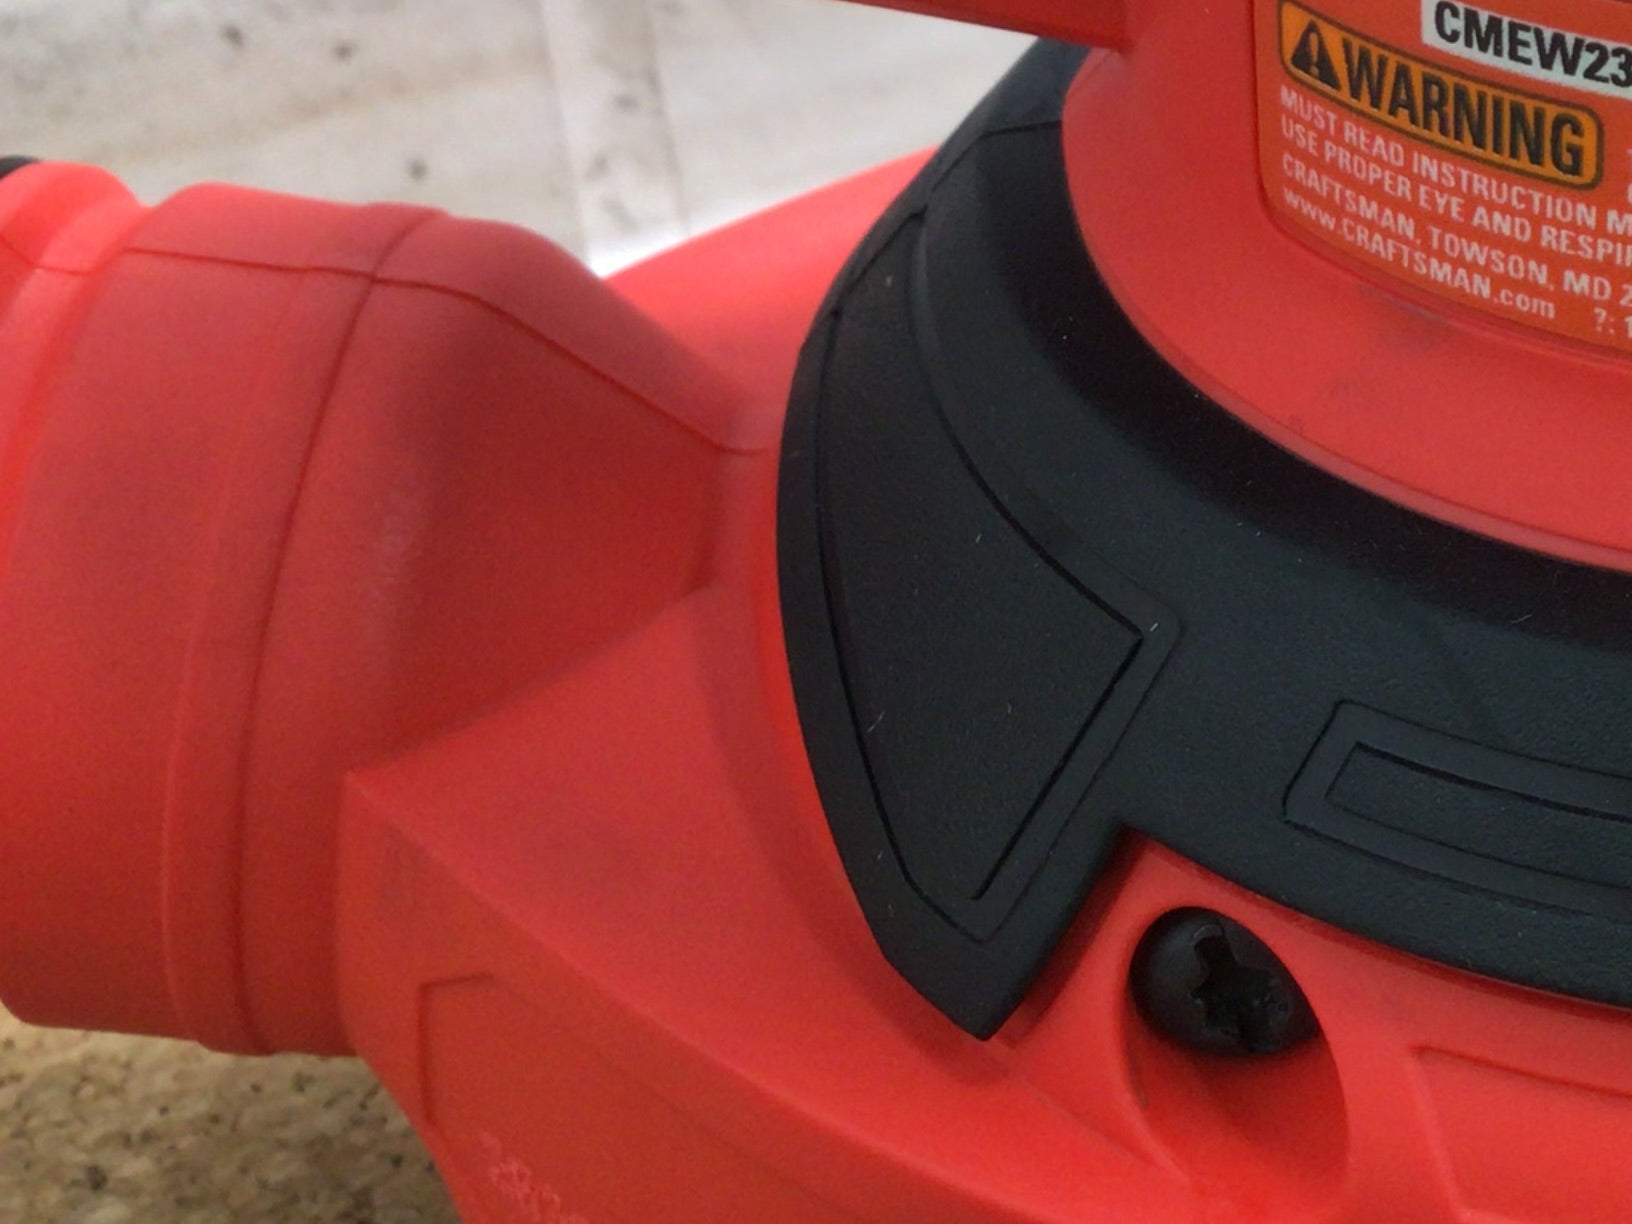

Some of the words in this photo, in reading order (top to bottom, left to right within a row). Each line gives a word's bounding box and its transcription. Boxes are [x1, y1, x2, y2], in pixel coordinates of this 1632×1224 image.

[1281, 85, 1337, 131] MUST
[1344, 121, 1404, 167] READ
[1413, 152, 1596, 229] INSTRUCTION
[1342, 38, 1585, 177] WARNING
[1282, 117, 1318, 155] USE
[1325, 142, 1411, 201] PROPER
[1419, 185, 1465, 221] EYE
[1472, 206, 1531, 242] AND
[1563, 269, 1611, 301] MD
